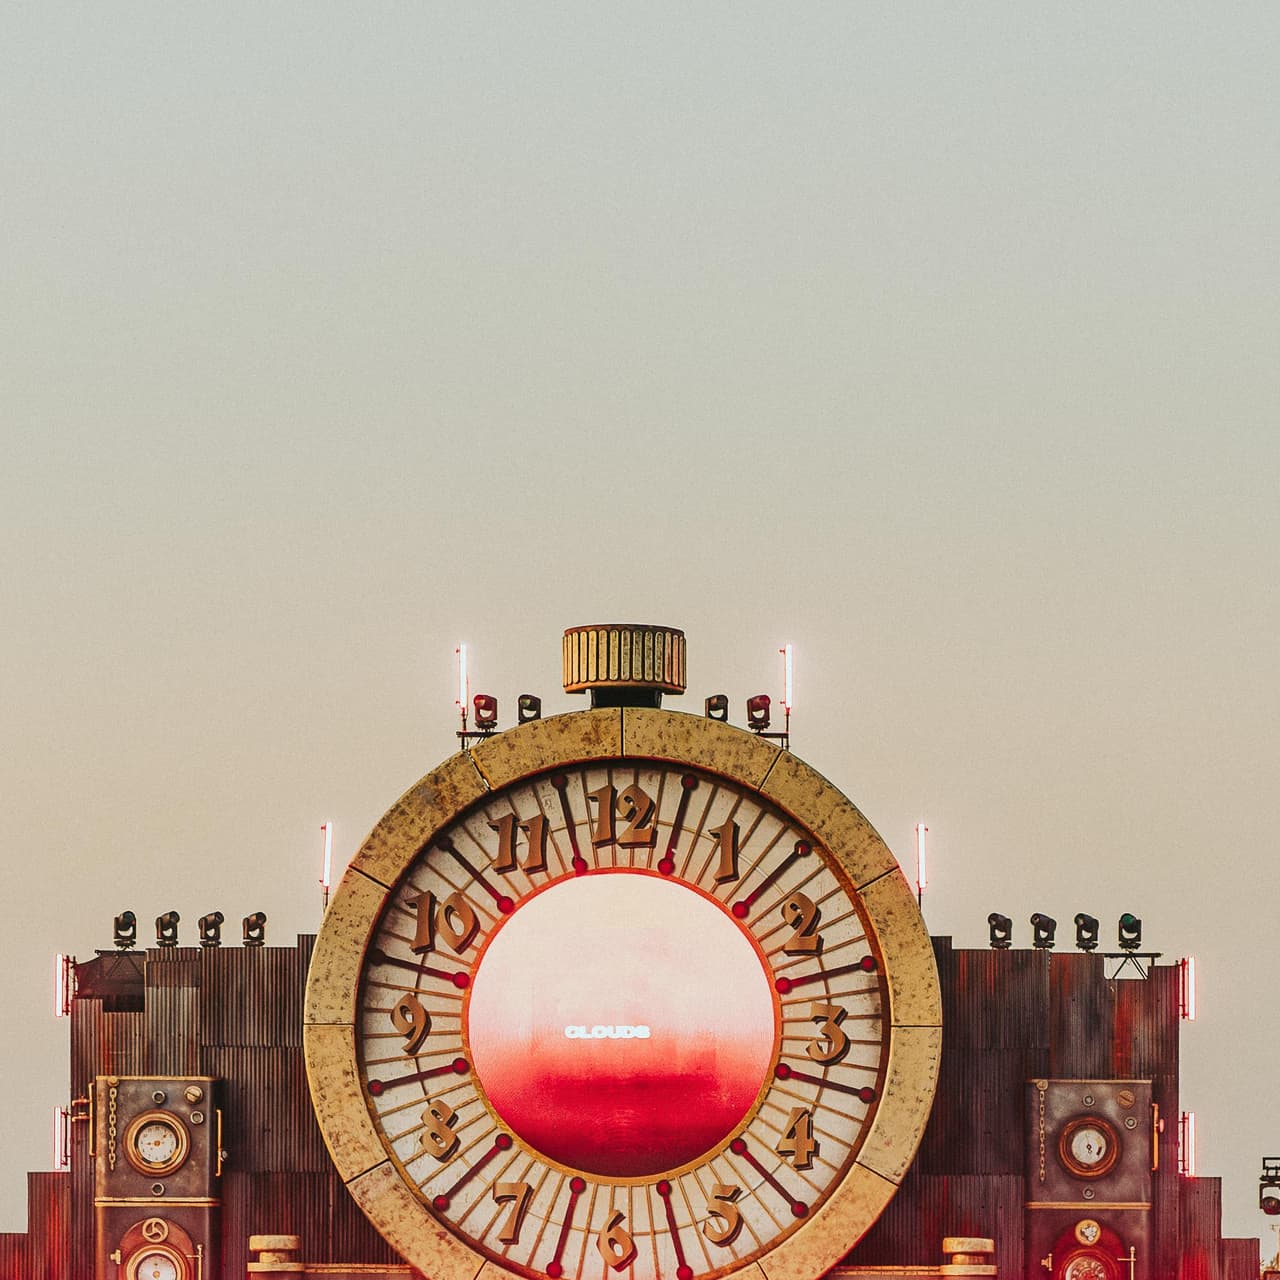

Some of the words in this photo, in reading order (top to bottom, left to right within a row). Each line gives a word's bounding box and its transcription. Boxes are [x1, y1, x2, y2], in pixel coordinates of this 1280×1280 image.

[487, 813, 548, 873] 11
[587, 783, 657, 848] 12
[709, 820, 740, 883] 1
[405, 890, 480, 954] 10
[781, 892, 823, 955] 2
[390, 994, 433, 1054] 9
[806, 1002, 851, 1065] 3
[420, 1099, 461, 1162] 8
[776, 1107, 818, 1170] 4
[493, 1182, 534, 1244] 7
[596, 1210, 637, 1271] 6
[703, 1184, 743, 1245] 5
